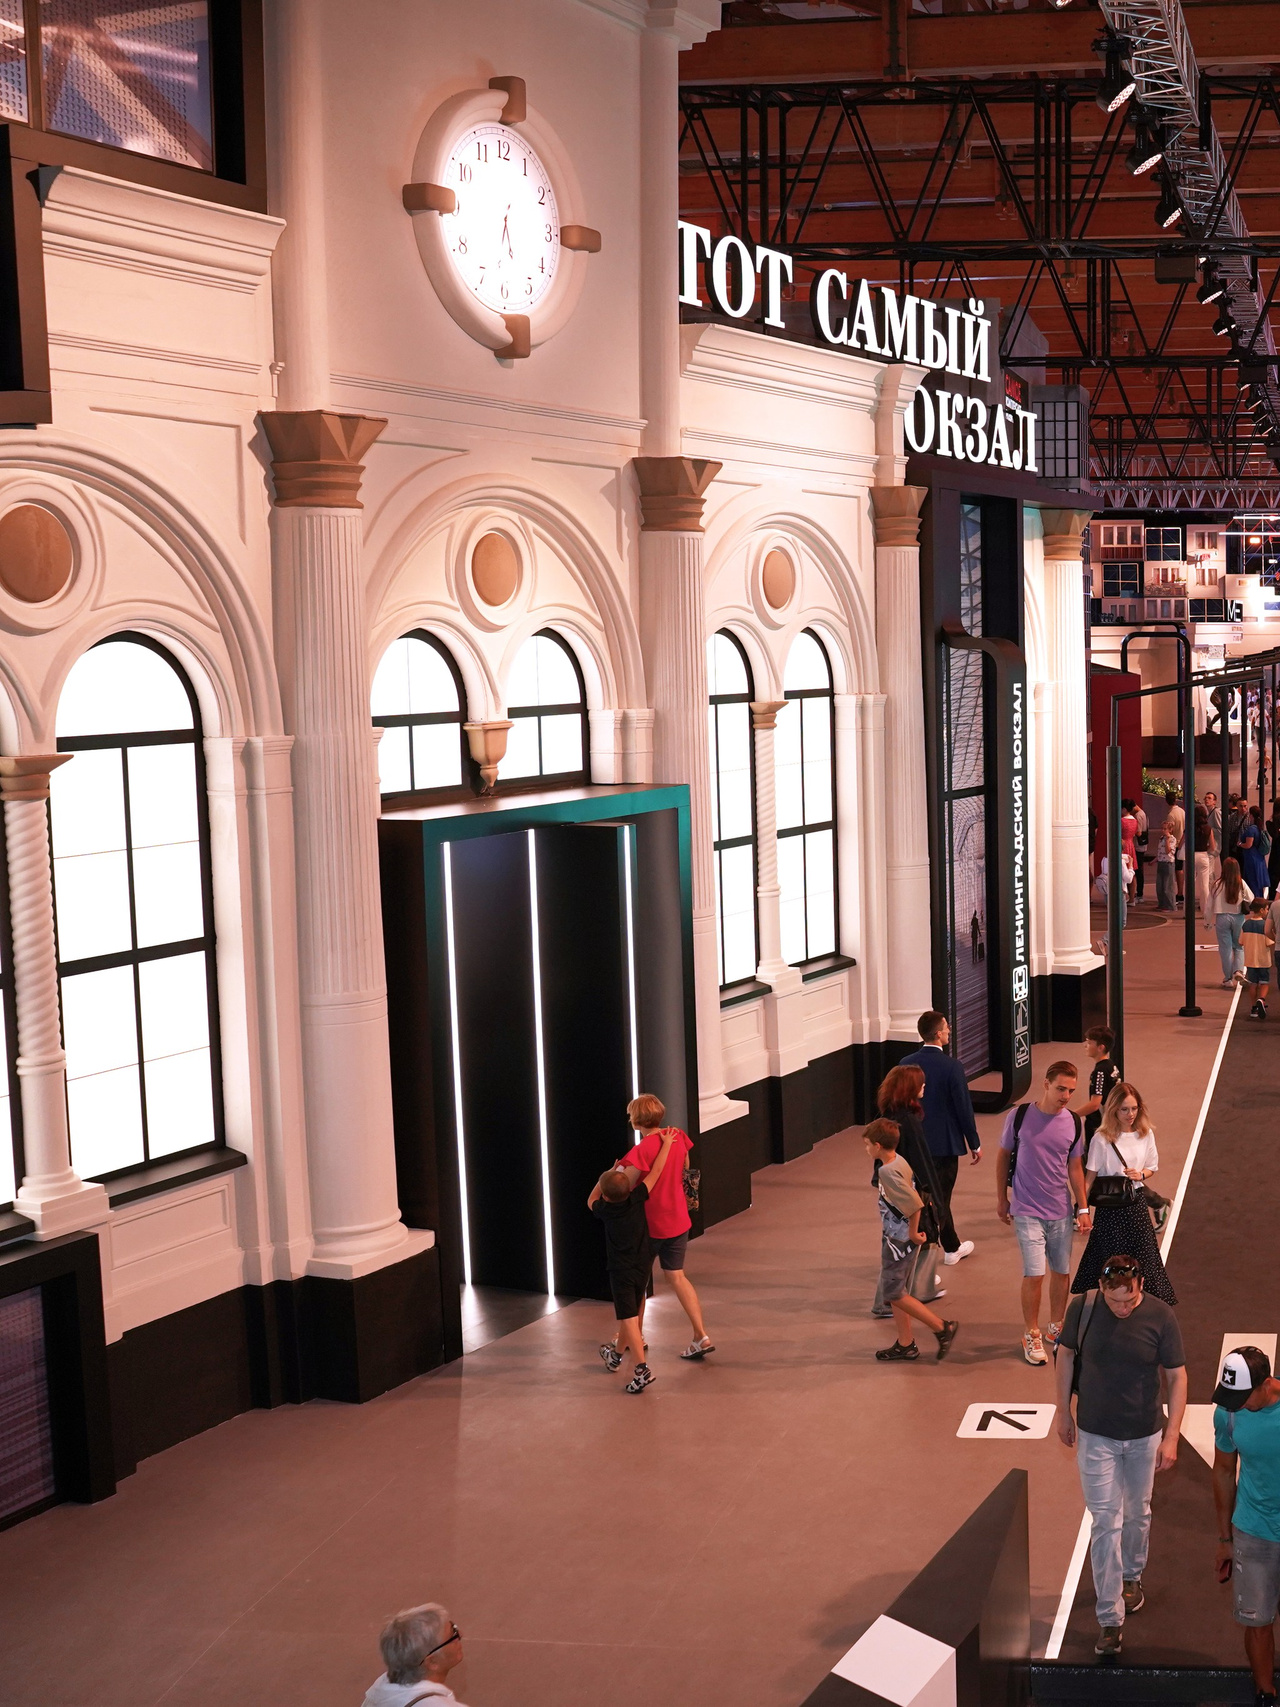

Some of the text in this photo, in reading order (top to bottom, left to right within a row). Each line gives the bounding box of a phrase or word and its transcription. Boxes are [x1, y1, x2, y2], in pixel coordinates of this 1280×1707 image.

[476, 141, 489, 163] 11
[496, 139, 511, 162] 12
[458, 162, 473, 184] 10
[522, 157, 528, 177] 1
[537, 185, 546, 206] 2
[544, 223, 553, 243] 3
[457, 234, 468, 255] 8
[537, 256, 546, 274] 4
[500, 280, 509, 300] 6
[524, 276, 533, 296] 5
[678, 219, 992, 383] ТОТ САМЫЙ
[904, 384, 1039, 473] ОКЗАЛ
[1012, 682, 1024, 963] ЛЕНИНГРАДСКИЙ ВОКЗАЛ
